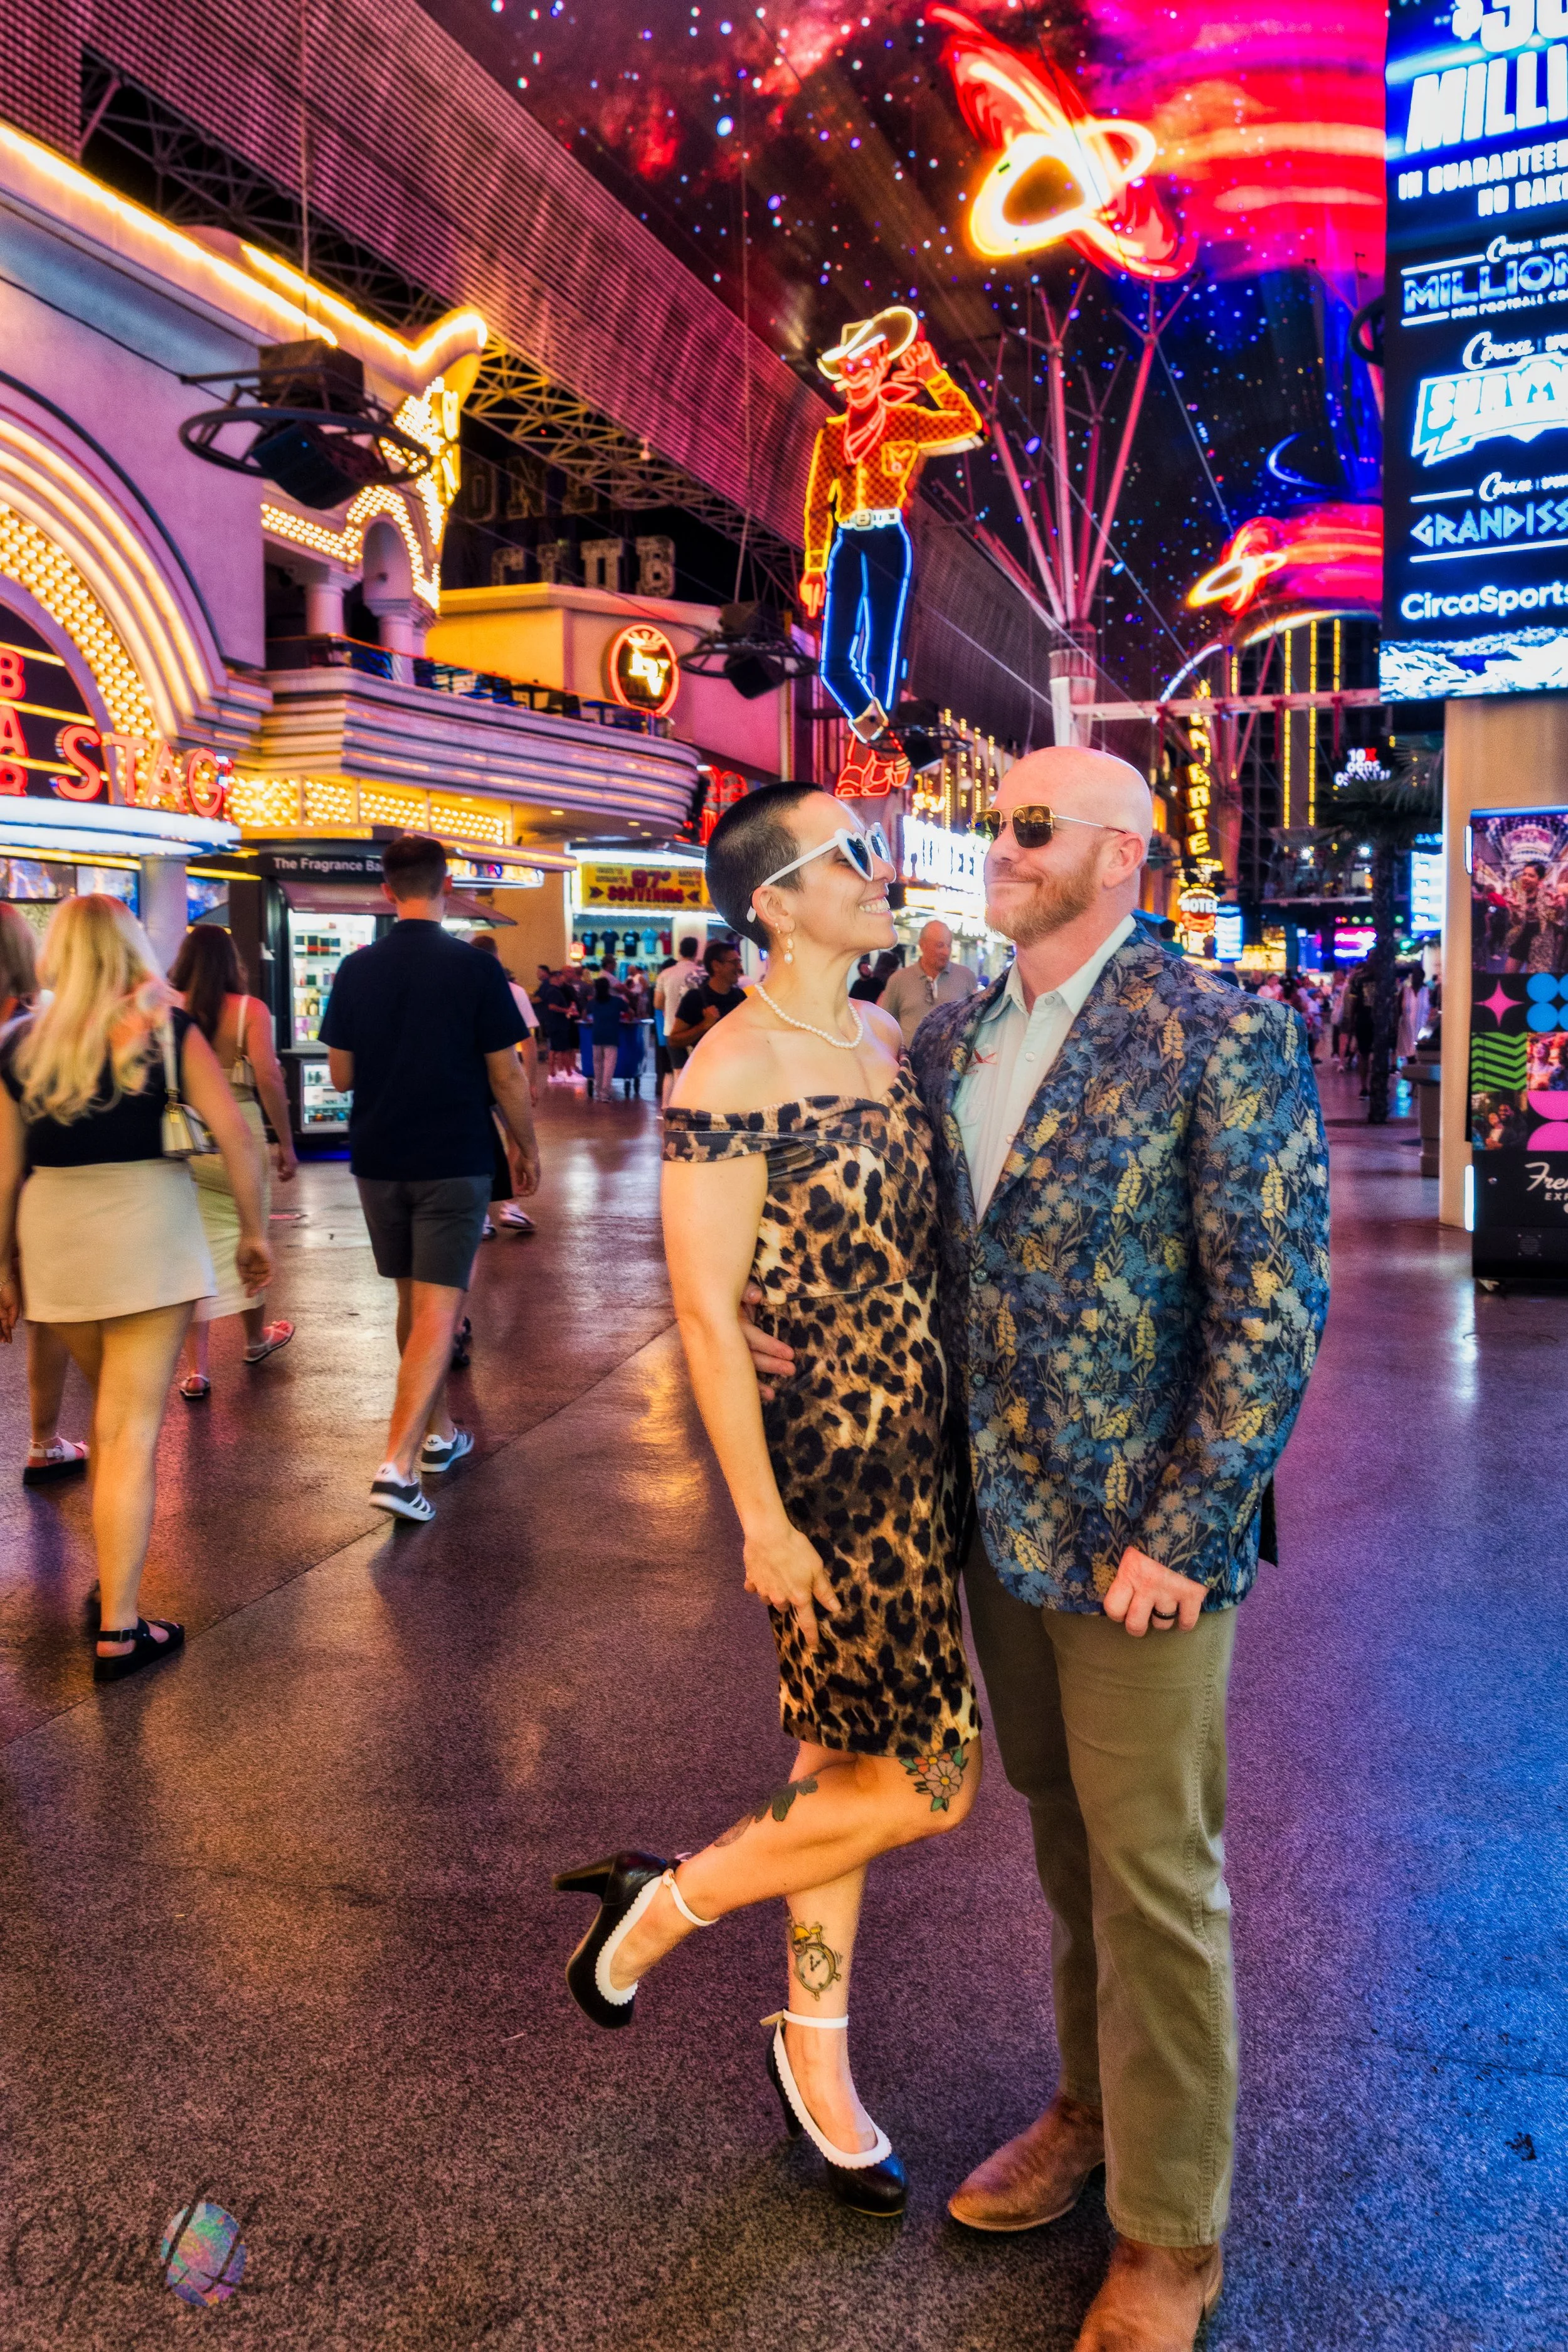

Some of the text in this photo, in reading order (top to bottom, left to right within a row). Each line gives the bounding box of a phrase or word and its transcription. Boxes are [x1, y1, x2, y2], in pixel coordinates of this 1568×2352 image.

[1398, 170, 1423, 200] IN
[1478, 185, 1510, 216] NO
[1463, 331, 1535, 370] Circa
[273, 857, 384, 872] The Fragrance Ba
